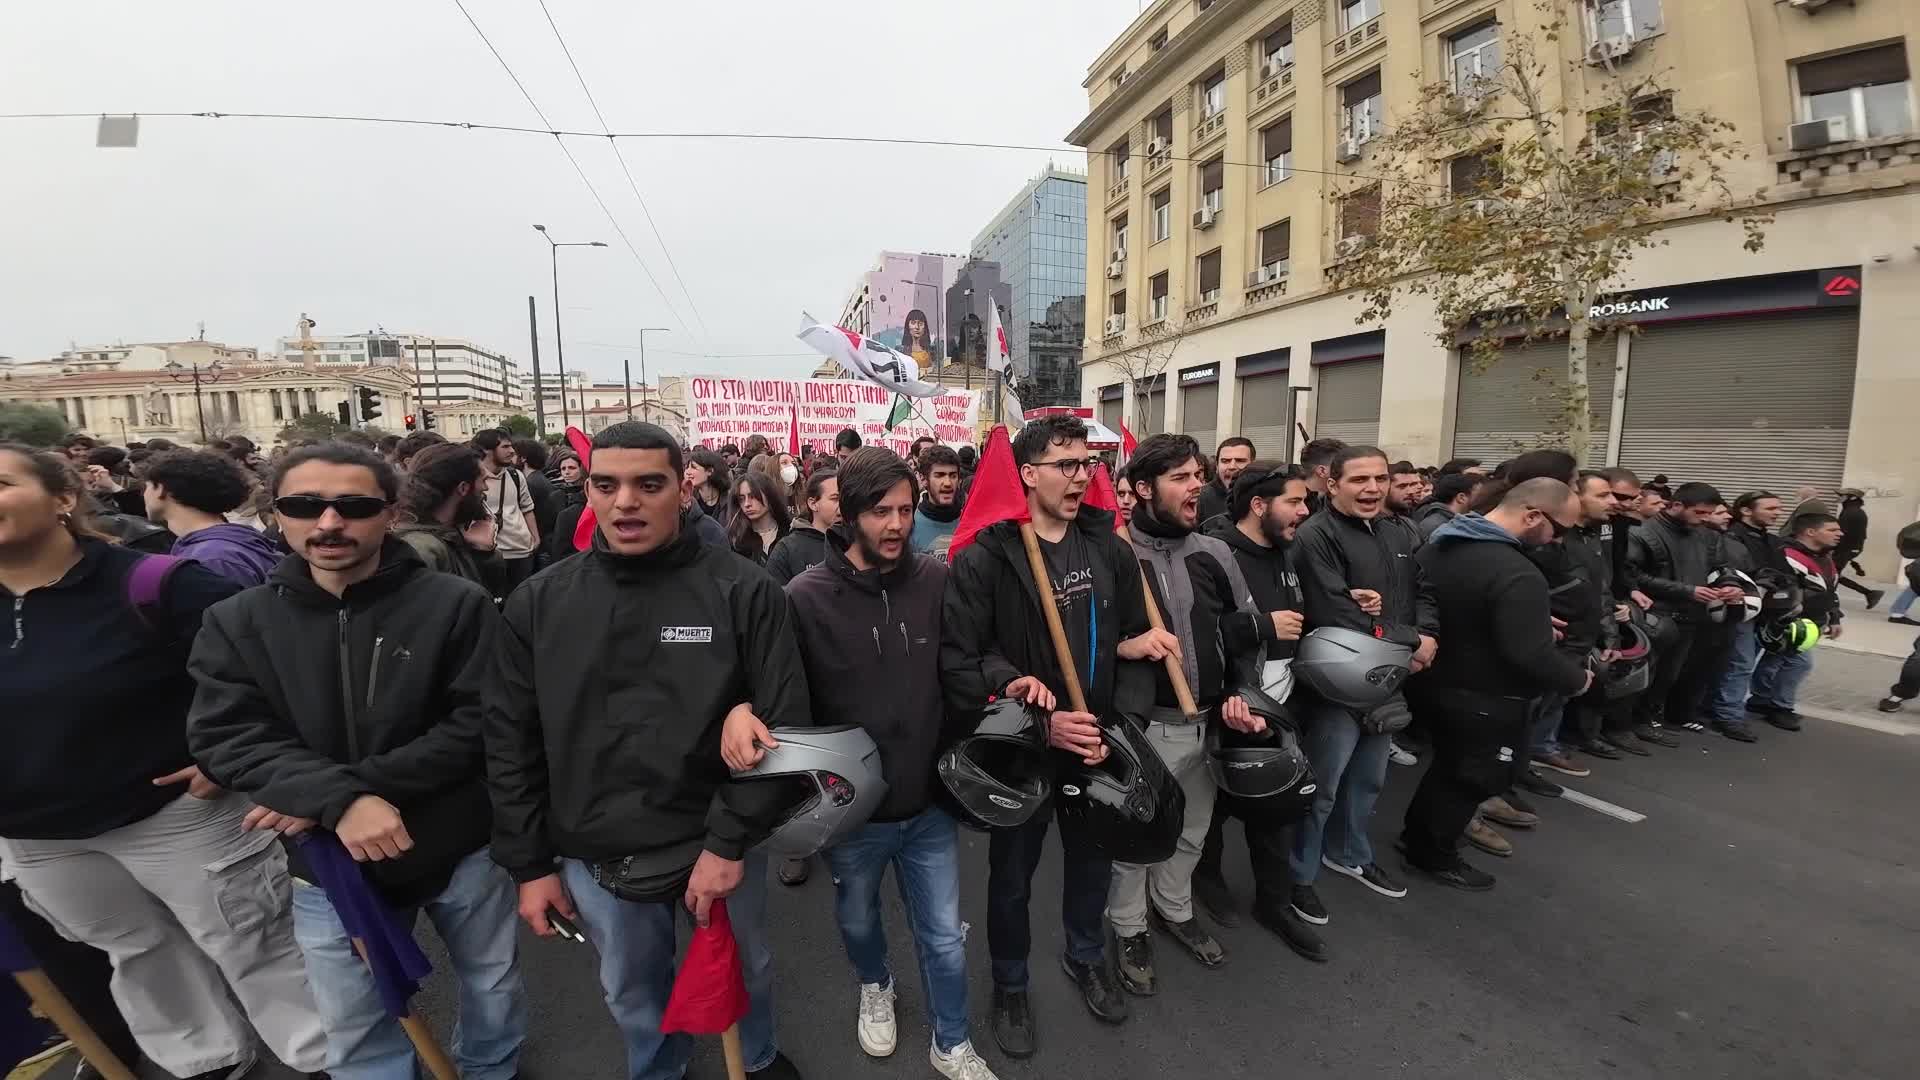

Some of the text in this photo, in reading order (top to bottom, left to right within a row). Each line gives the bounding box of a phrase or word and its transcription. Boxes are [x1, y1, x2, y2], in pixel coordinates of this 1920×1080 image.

[1566, 297, 1670, 319] ROBANK
[1182, 368, 1214, 381] EUROBANK
[692, 378, 717, 399] ΟΧΙ
[720, 379, 746, 400] ΣΤΑ
